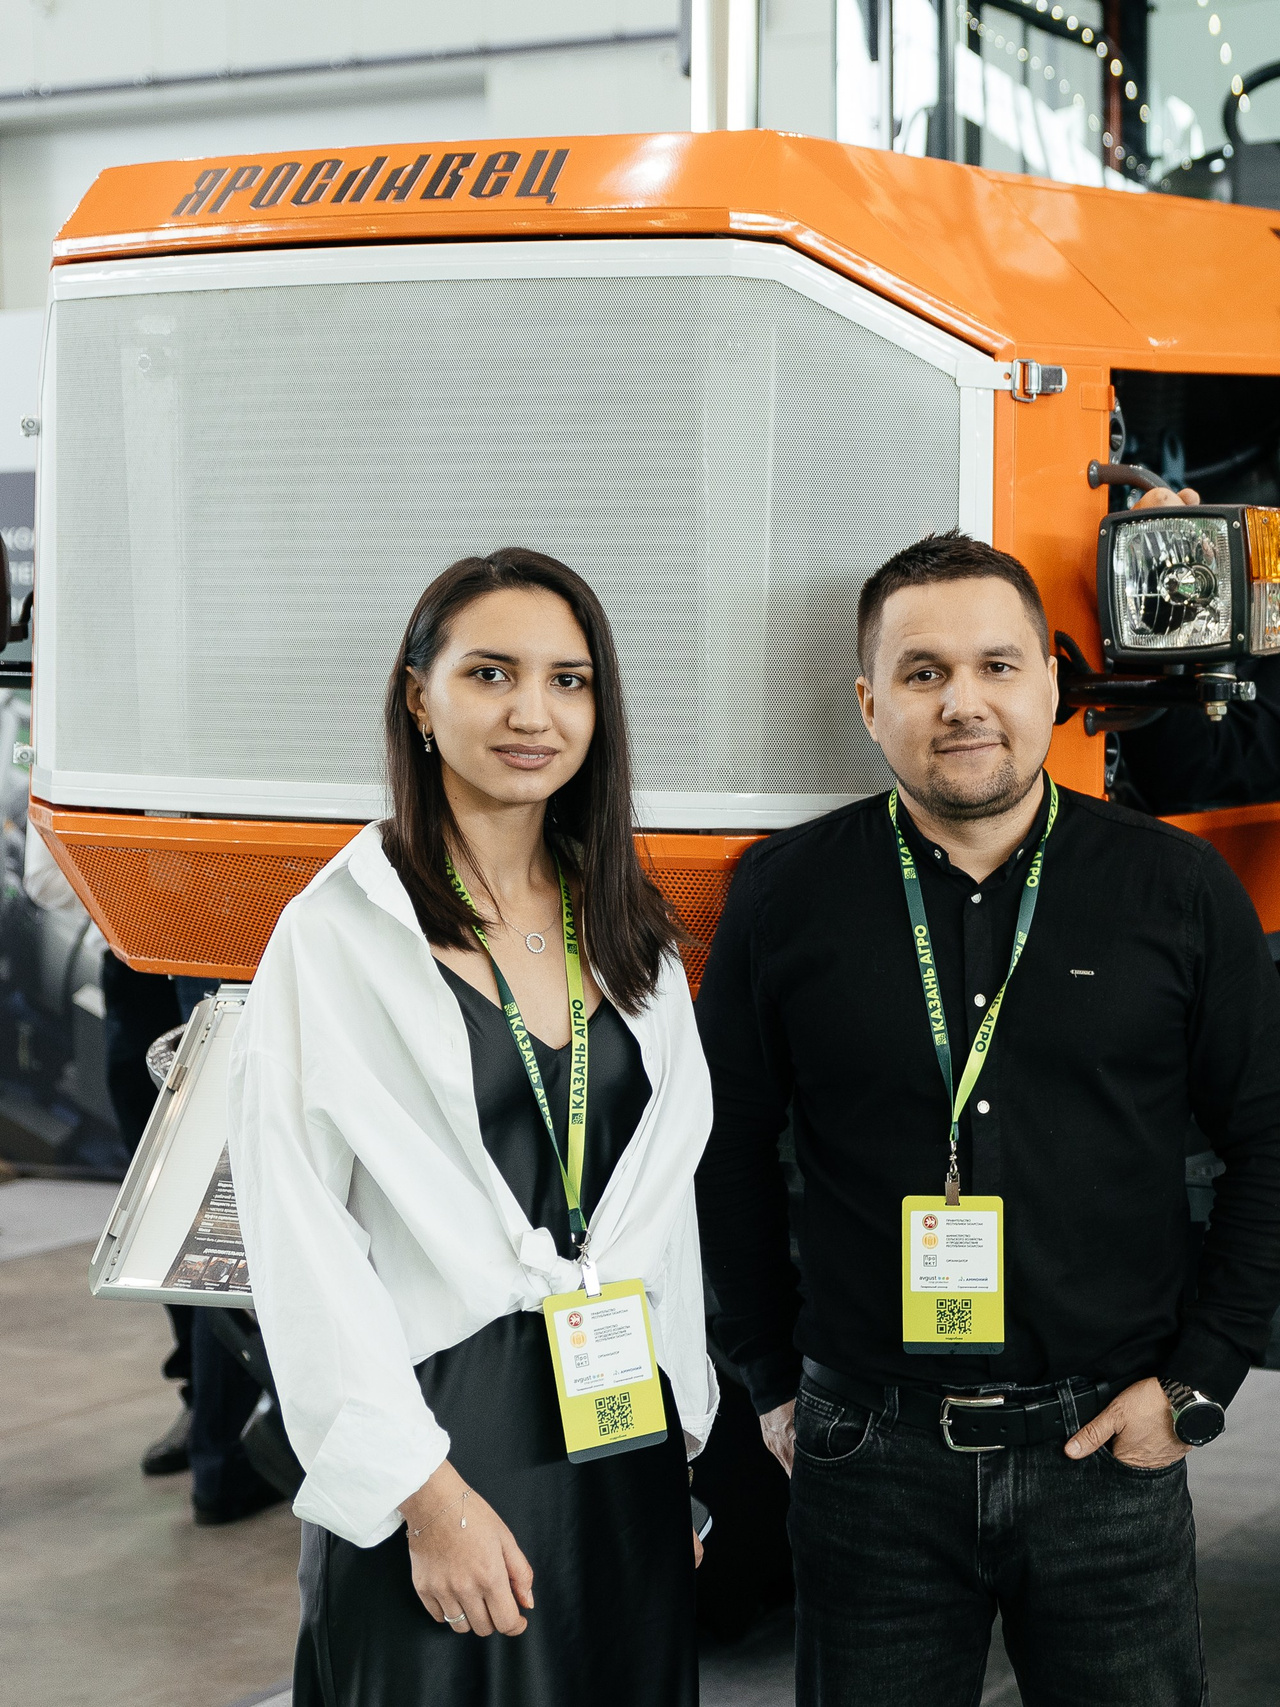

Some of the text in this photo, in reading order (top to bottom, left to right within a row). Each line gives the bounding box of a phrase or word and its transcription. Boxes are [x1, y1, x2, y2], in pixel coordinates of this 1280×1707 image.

[172, 148, 570, 216] ЯРОСЛАВЕЦ
[914, 924, 945, 1034] КАЗАНЬ АГРО
[509, 1017, 553, 1130] КАЗАНЬ АГРО
[571, 999, 585, 1110] КАЗАНЬ АГРО
[975, 1013, 995, 1053] АГРО
[574, 1376, 592, 1384] avgust
